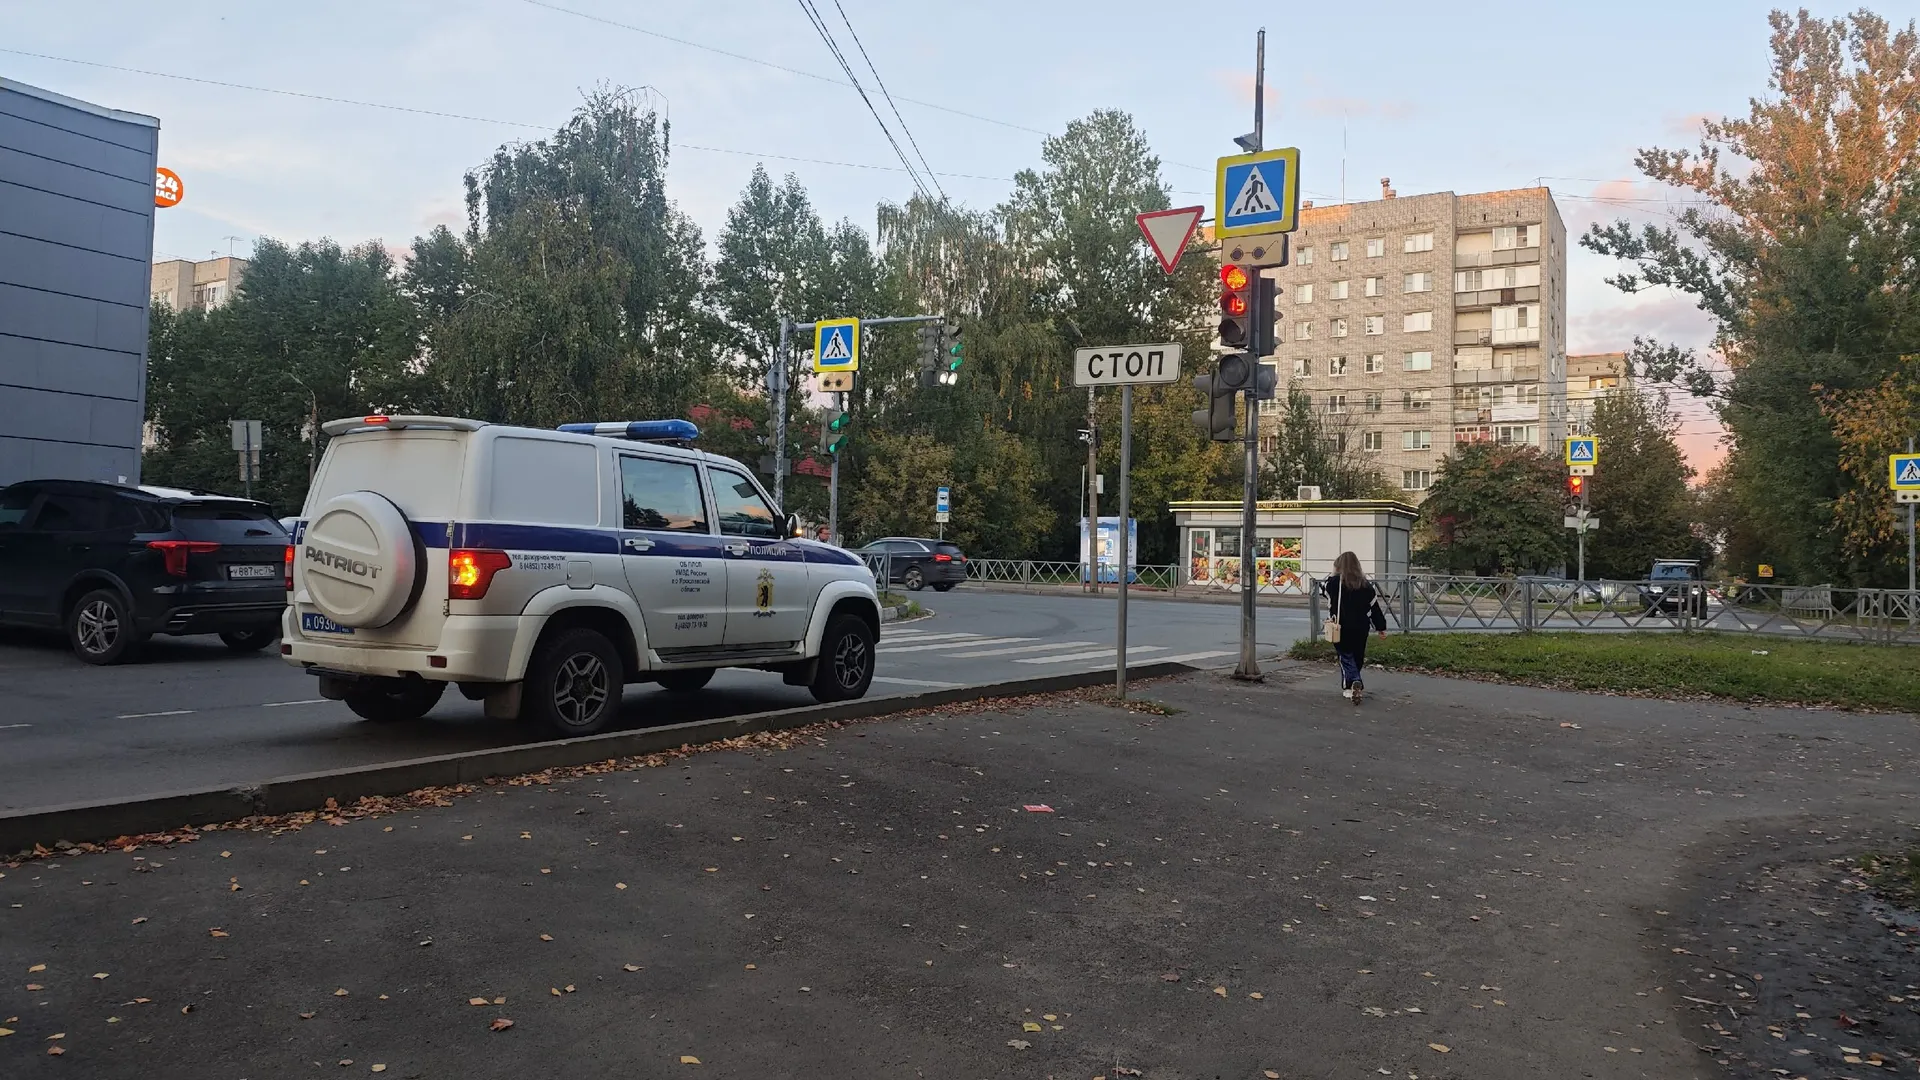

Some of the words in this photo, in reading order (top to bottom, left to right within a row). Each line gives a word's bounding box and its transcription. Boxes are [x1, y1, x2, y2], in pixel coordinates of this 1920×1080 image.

[1088, 351, 1163, 378] СТОП
[305, 546, 382, 578] PATRIOT
[750, 545, 787, 556] ПОЛИЦИЯ
